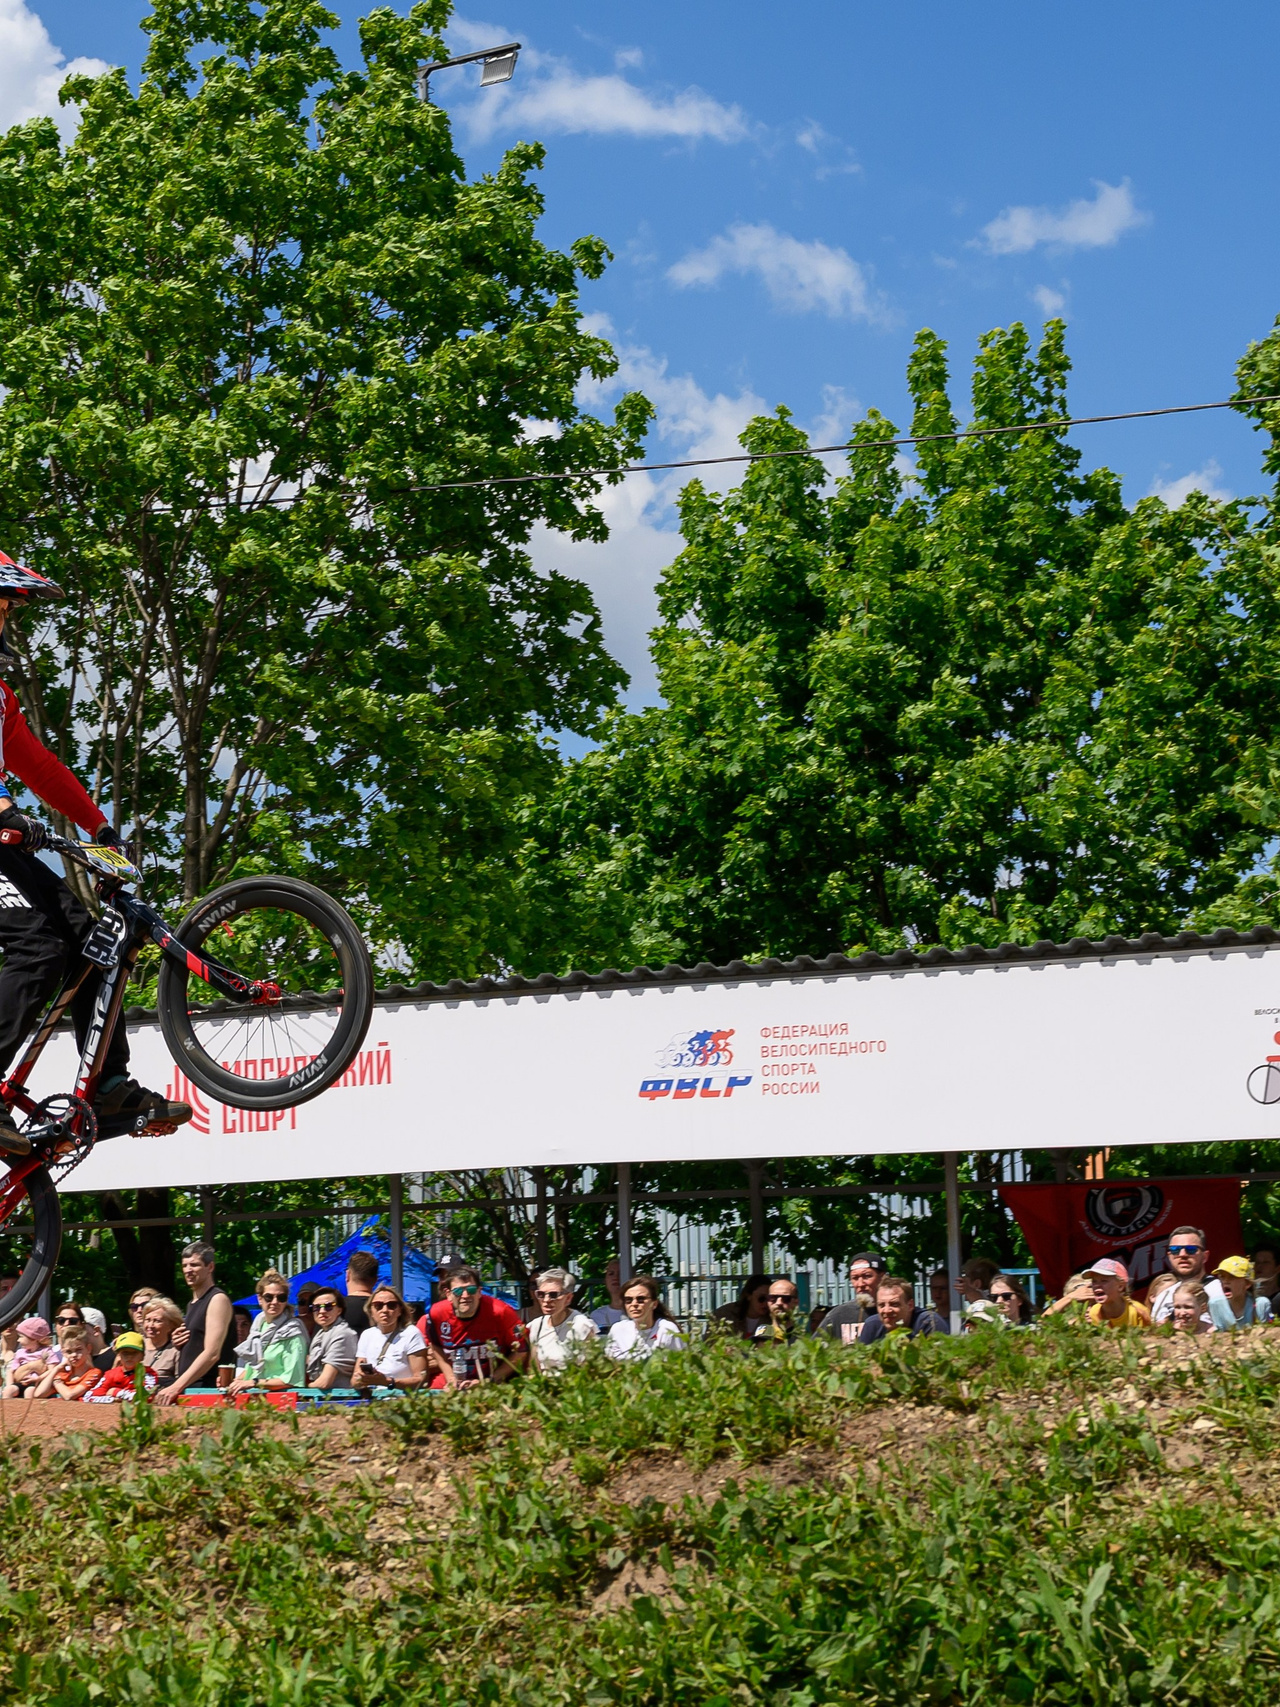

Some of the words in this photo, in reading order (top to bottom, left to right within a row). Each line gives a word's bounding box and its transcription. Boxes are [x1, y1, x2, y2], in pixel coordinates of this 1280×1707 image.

[760, 1022, 849, 1041] ФЕДЕРАЦИЯ
[760, 1040, 887, 1058] ВЕЛОСИПЕДНОГО
[289, 1053, 329, 1089] AVIAN
[761, 1062, 817, 1077] СПОРТА
[638, 1070, 754, 1100] ФВСР
[762, 1081, 820, 1096] РОССИИ
